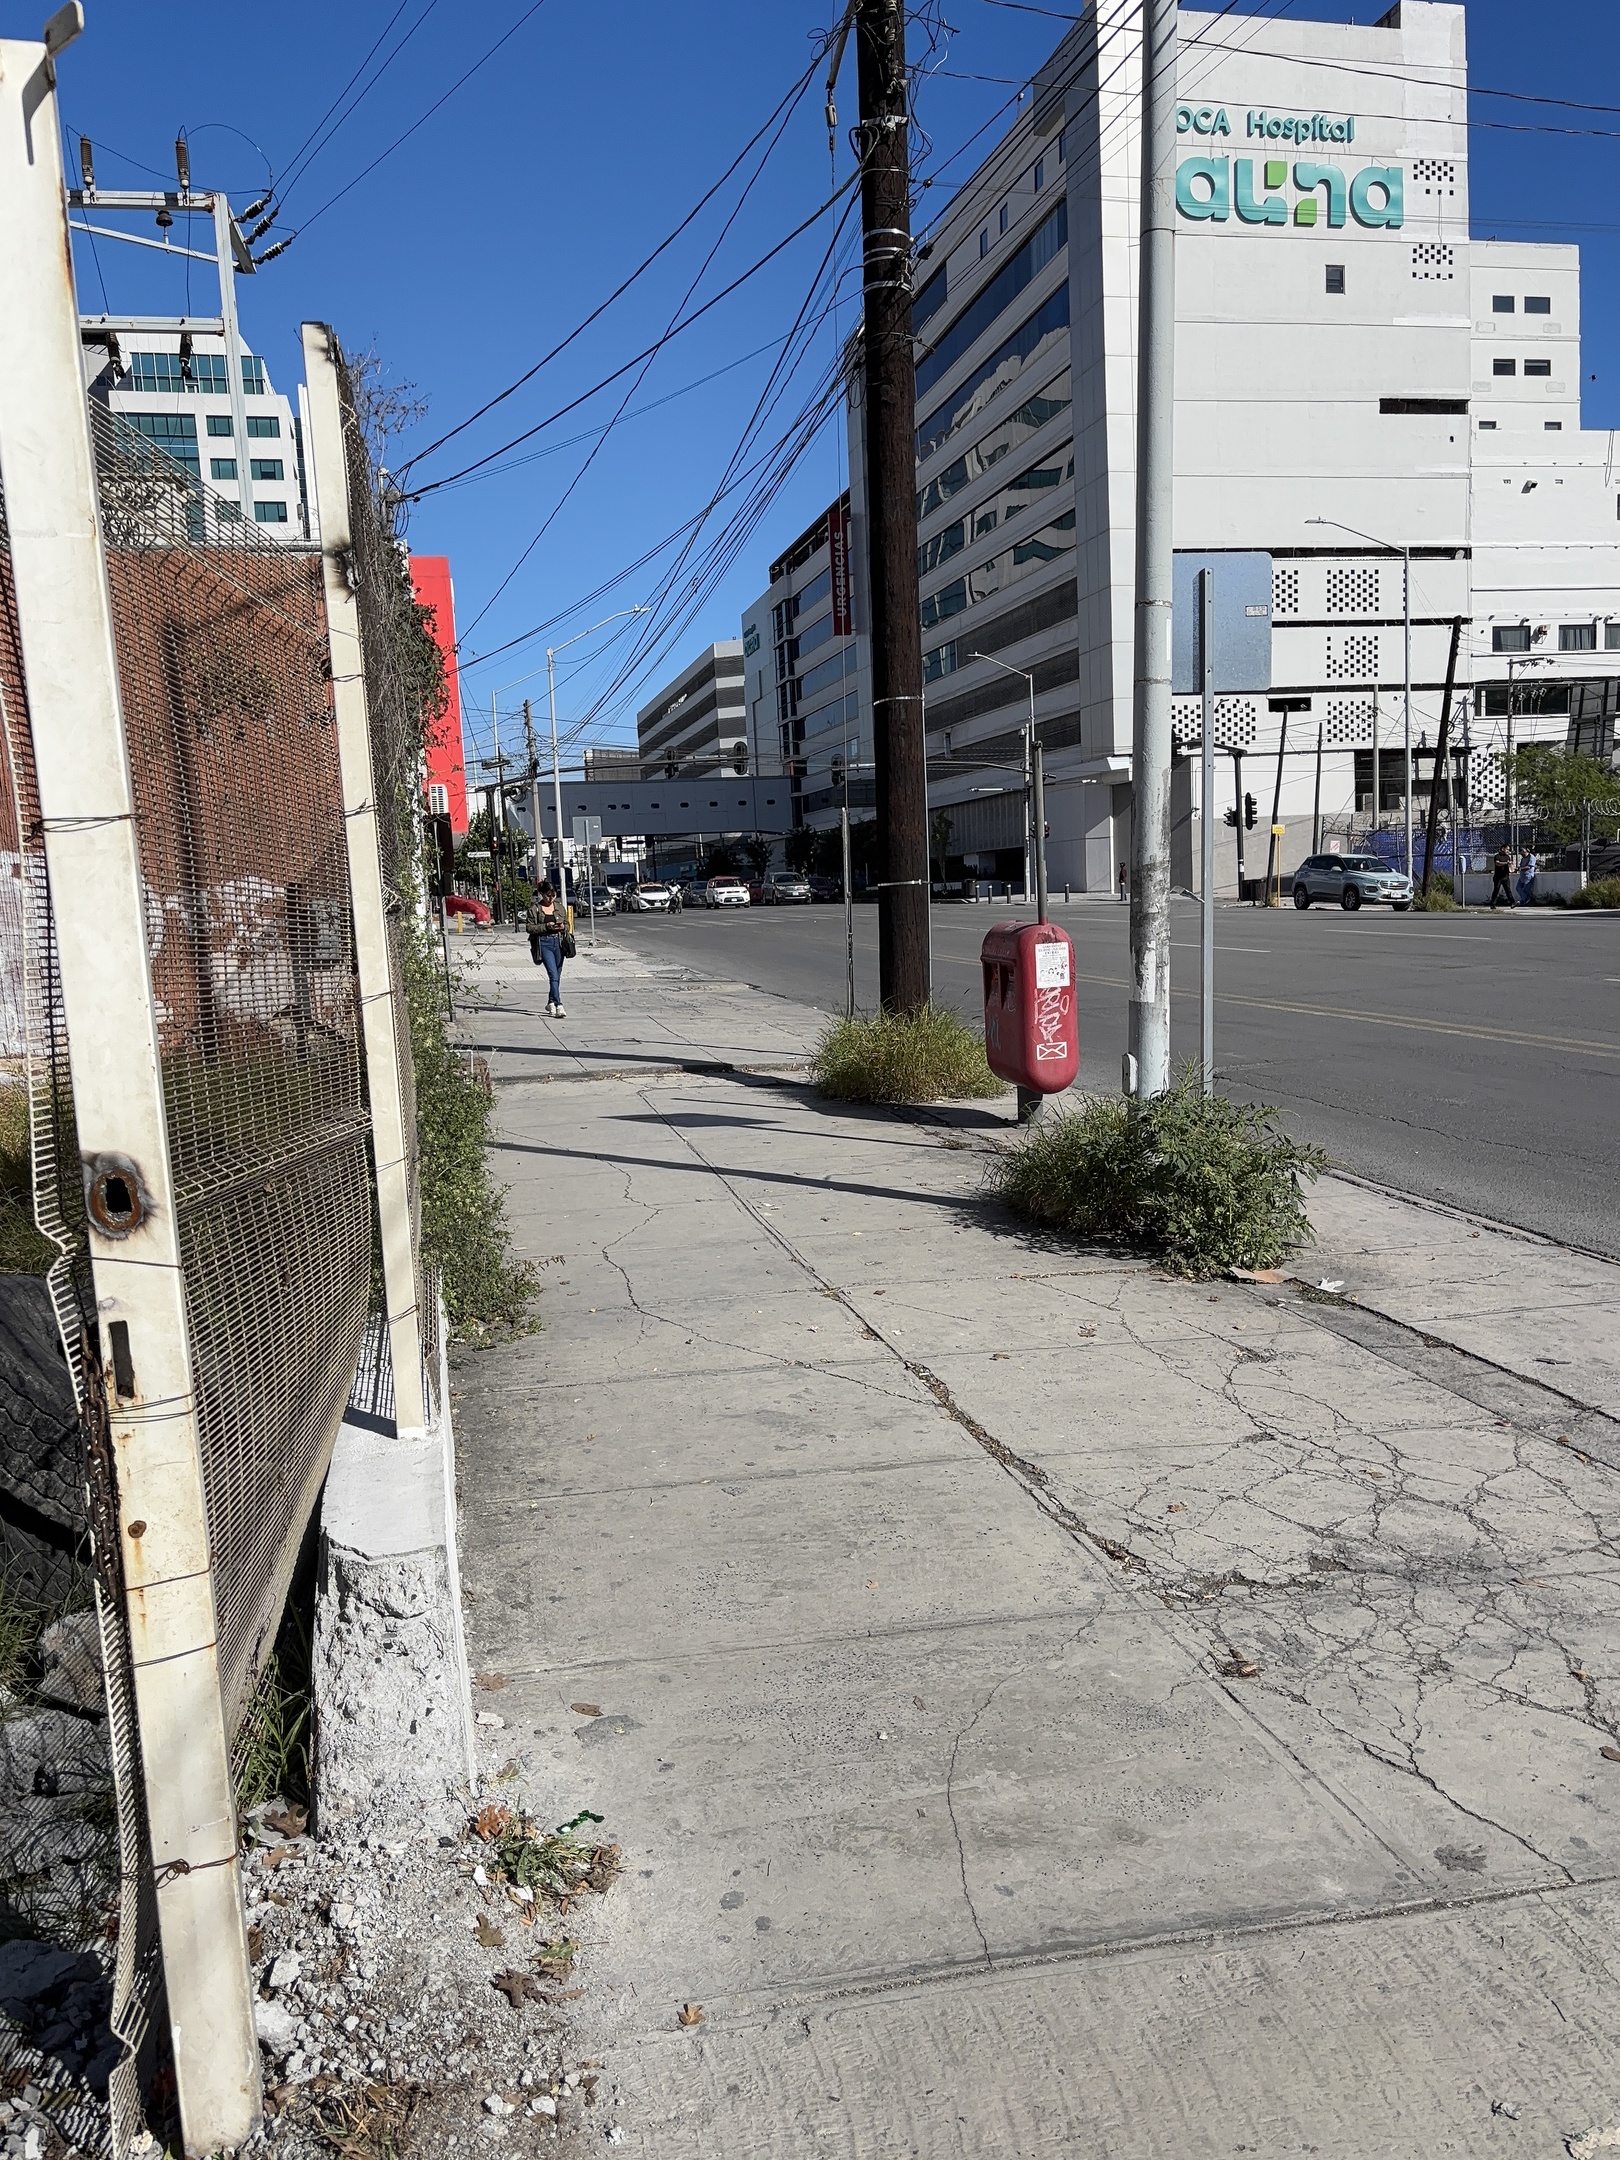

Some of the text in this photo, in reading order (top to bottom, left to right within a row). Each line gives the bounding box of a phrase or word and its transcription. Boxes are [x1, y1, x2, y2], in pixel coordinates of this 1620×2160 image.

[1176, 105, 1355, 145] OCA Hospital
[833, 531, 848, 617] URGENCIAS
